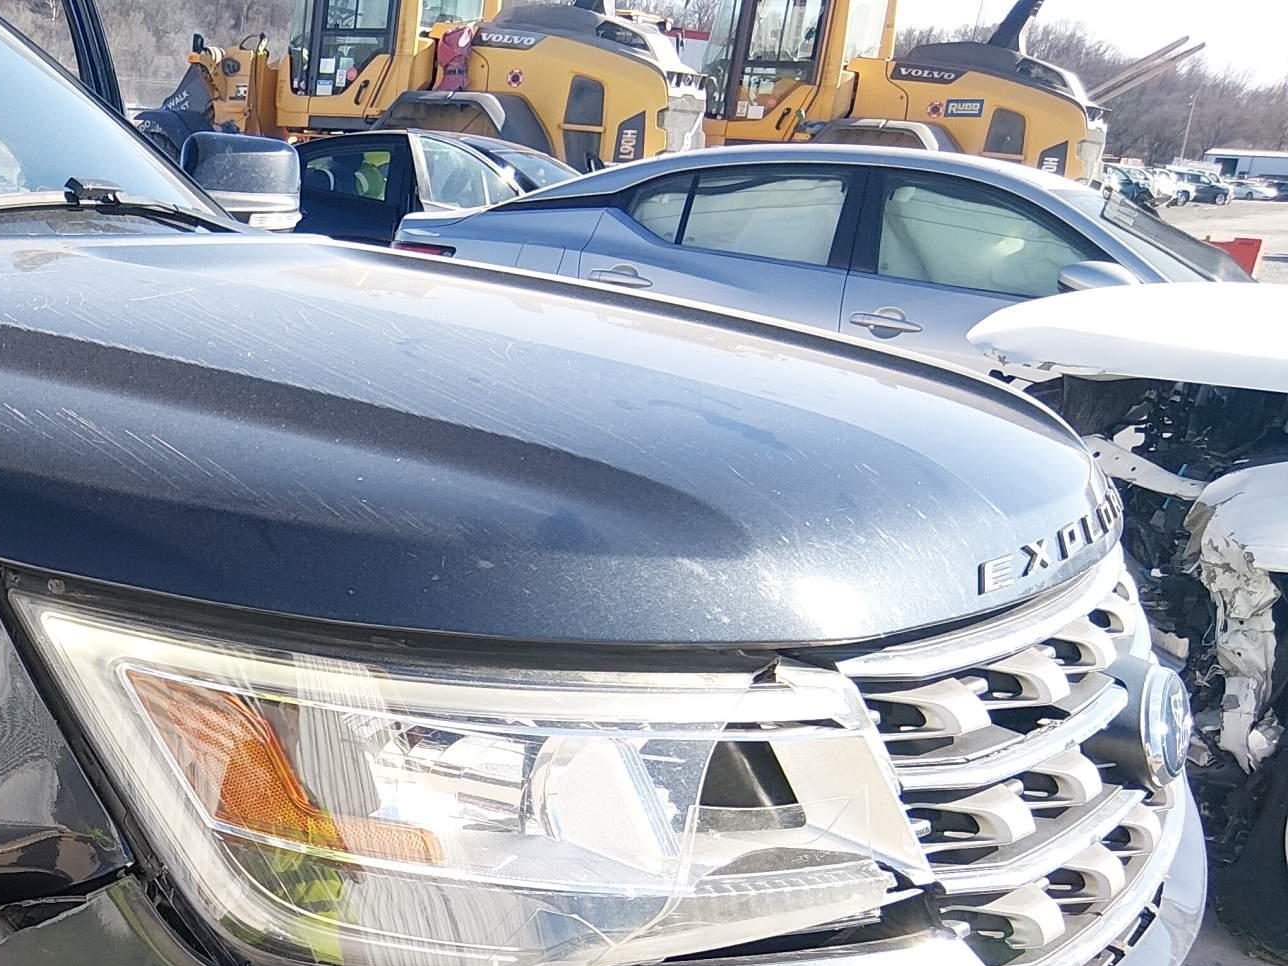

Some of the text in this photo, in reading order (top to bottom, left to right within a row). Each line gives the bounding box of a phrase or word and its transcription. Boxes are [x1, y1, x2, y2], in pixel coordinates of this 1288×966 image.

[480, 32, 536, 46] VOLVO
[899, 67, 956, 81] VOLVO
[167, 89, 190, 110] WALK
[618, 129, 638, 160] L90H
[1041, 156, 1060, 173] 0H
